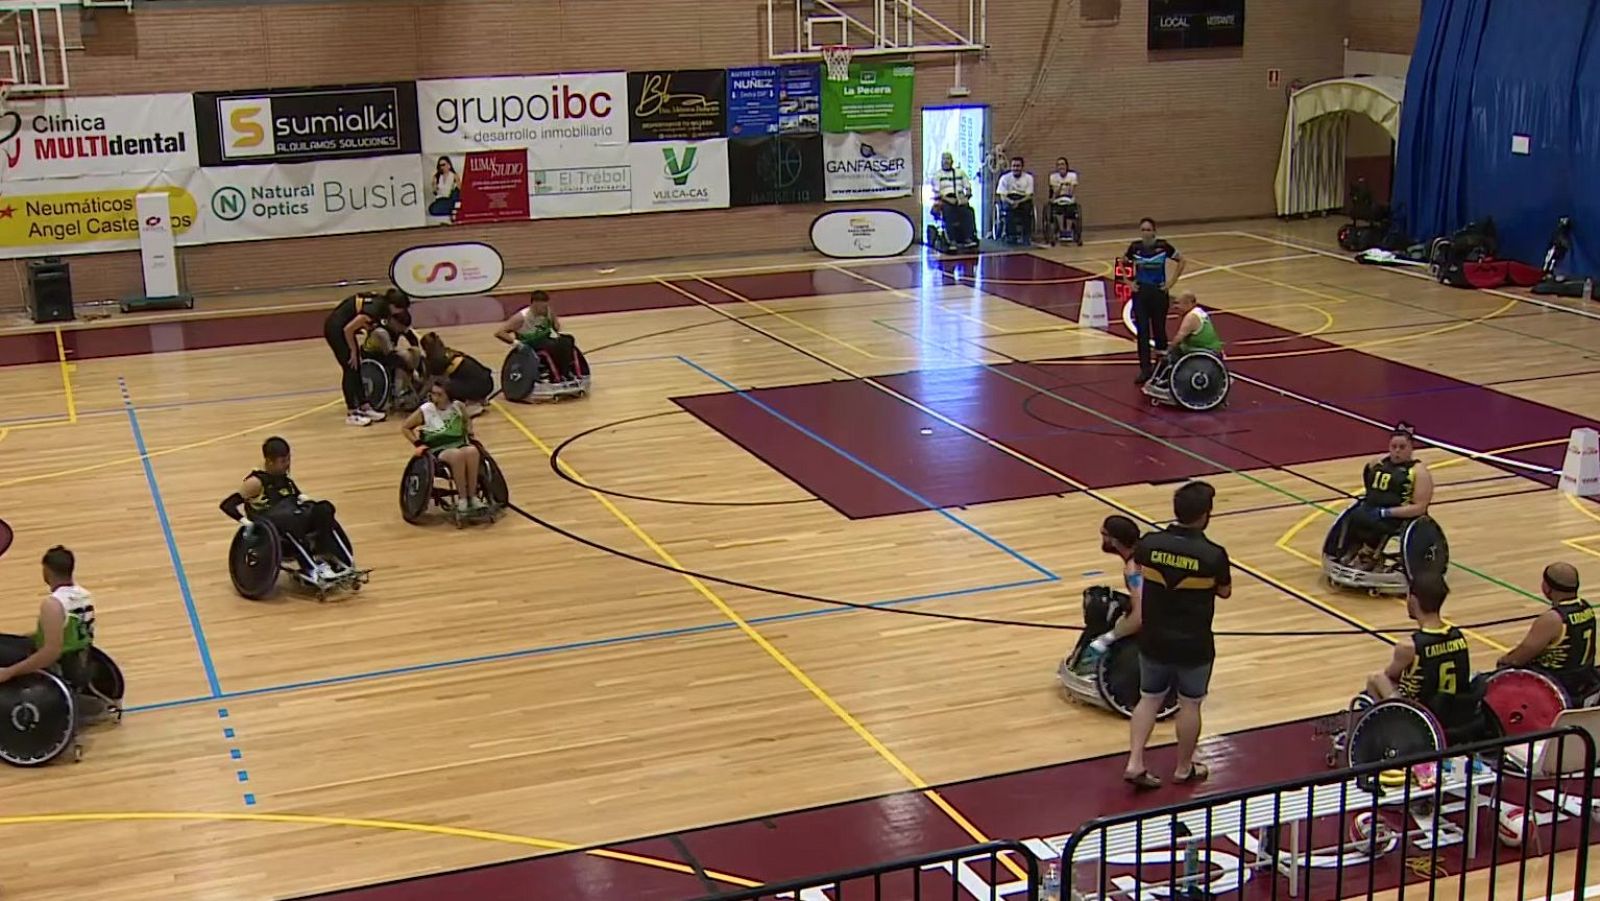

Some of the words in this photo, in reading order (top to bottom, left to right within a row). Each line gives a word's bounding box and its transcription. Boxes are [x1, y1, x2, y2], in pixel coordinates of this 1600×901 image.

[733, 77, 773, 89] NUÑEZ
[436, 84, 612, 133] grupoibc
[276, 104, 395, 136] sumialki
[276, 139, 337, 151] ALQUILAMOS
[339, 136, 397, 148] SOLUCIONES
[473, 127, 537, 143] desarrollo
[541, 124, 613, 140] inmobiliario
[34, 131, 186, 160] MULTIdental
[826, 157, 905, 174] GANFASSER
[251, 183, 316, 200] Natural
[323, 175, 418, 213] Busia
[653, 187, 709, 200] VULCA-CAS
[26, 196, 134, 217] Neumáticos
[252, 202, 310, 219] Optics
[28, 219, 82, 240] Angel
[1372, 471, 1392, 492] 18
[1150, 550, 1200, 572] CATALUNYA
[1438, 661, 1457, 695] 6
